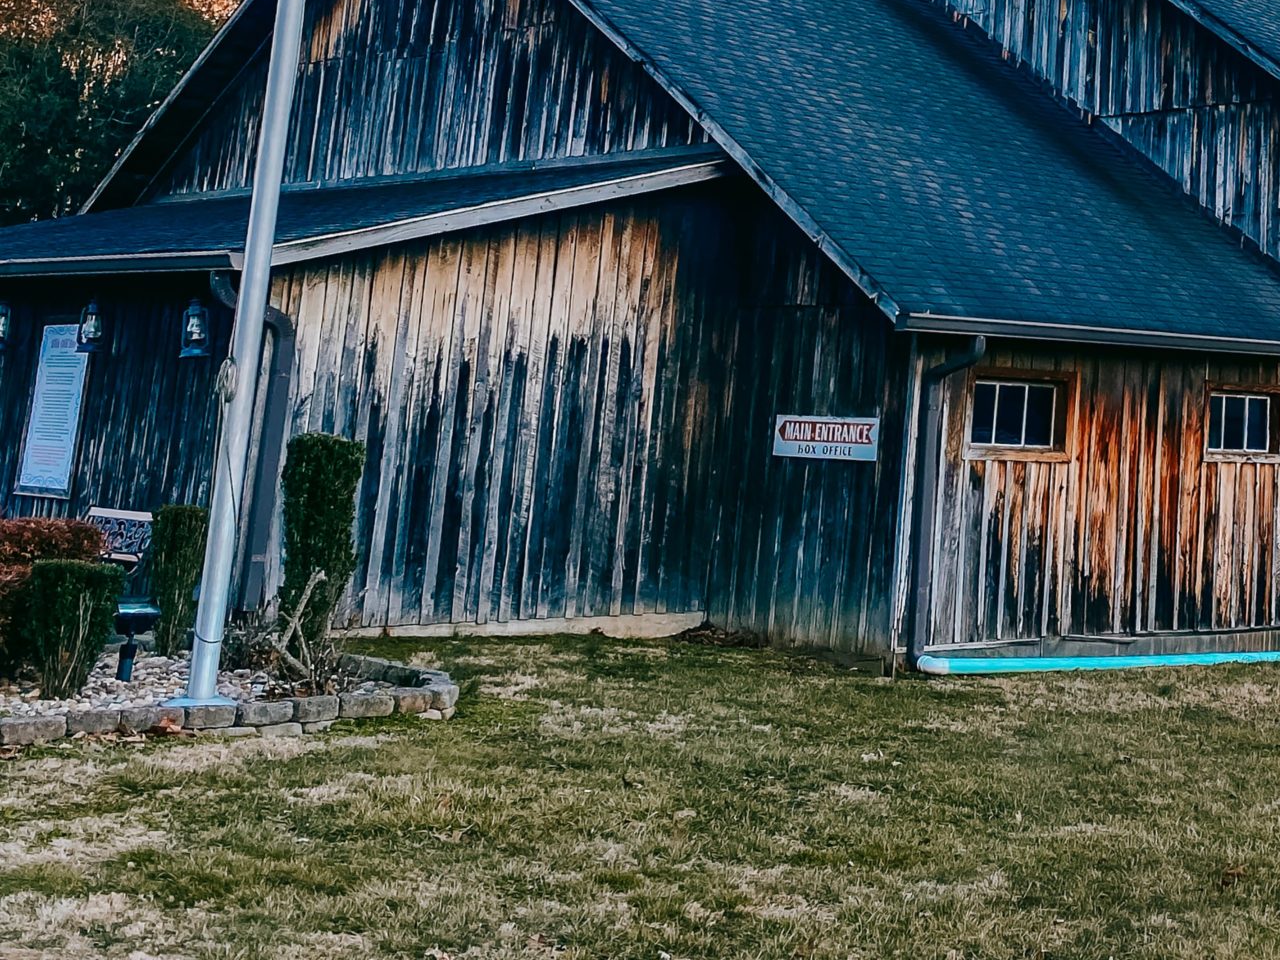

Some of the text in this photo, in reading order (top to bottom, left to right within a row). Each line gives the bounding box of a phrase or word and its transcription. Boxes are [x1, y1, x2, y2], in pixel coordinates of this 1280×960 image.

[784, 421, 870, 443] MAIN ENTRANCE
[797, 443, 853, 457] BOX OFFICE
